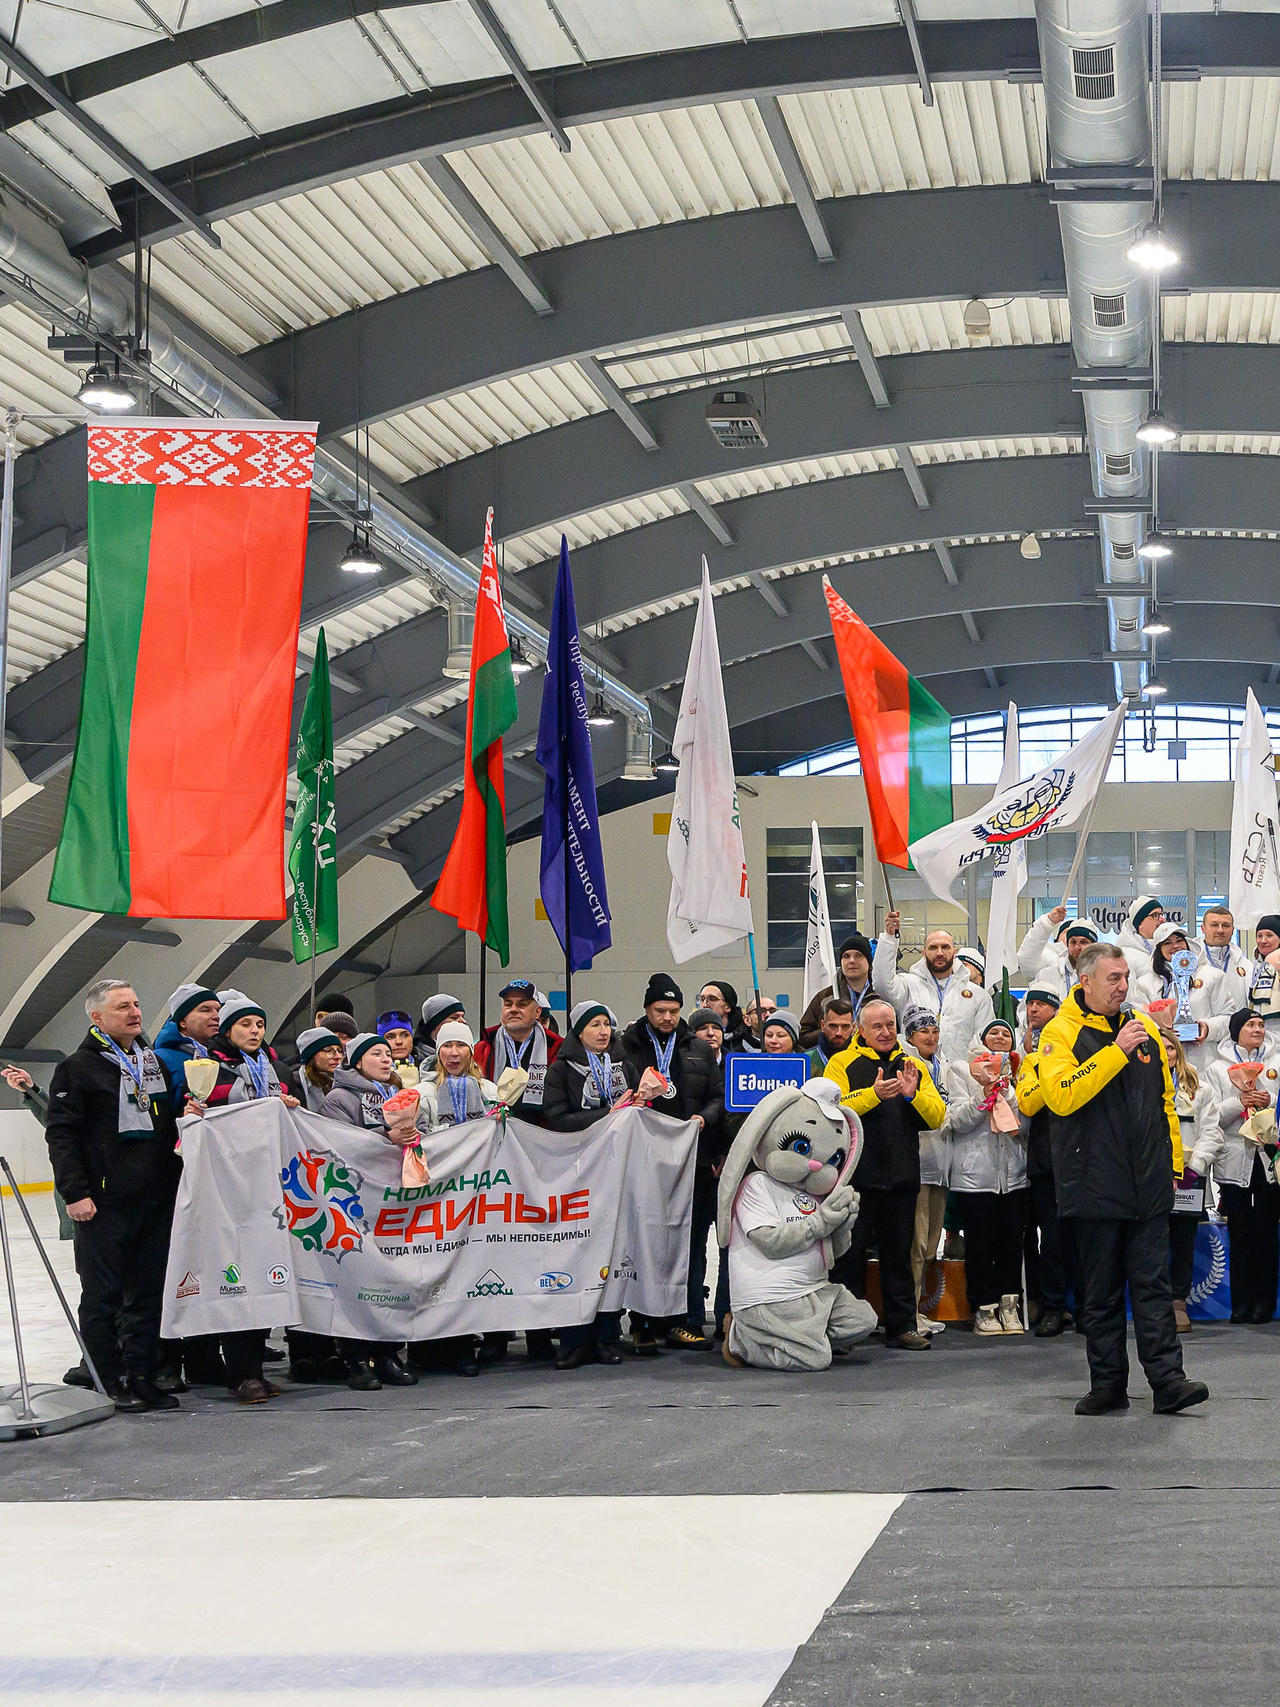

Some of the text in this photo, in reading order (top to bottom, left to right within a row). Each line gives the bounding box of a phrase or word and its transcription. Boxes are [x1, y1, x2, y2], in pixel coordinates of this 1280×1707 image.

[738, 1073, 798, 1092] Единые
[383, 1168, 512, 1203] КОМАНДА
[373, 1188, 590, 1244] ЕДИНЫЕ
[412, 1243, 433, 1255] МЫ
[436, 1236, 469, 1253] ЕДИНЫ
[486, 1233, 507, 1244] МЫ
[509, 1228, 591, 1244] НЕПОБЕДИМЫ!
[357, 1292, 411, 1303] ВОСТОЧНЫЙ
